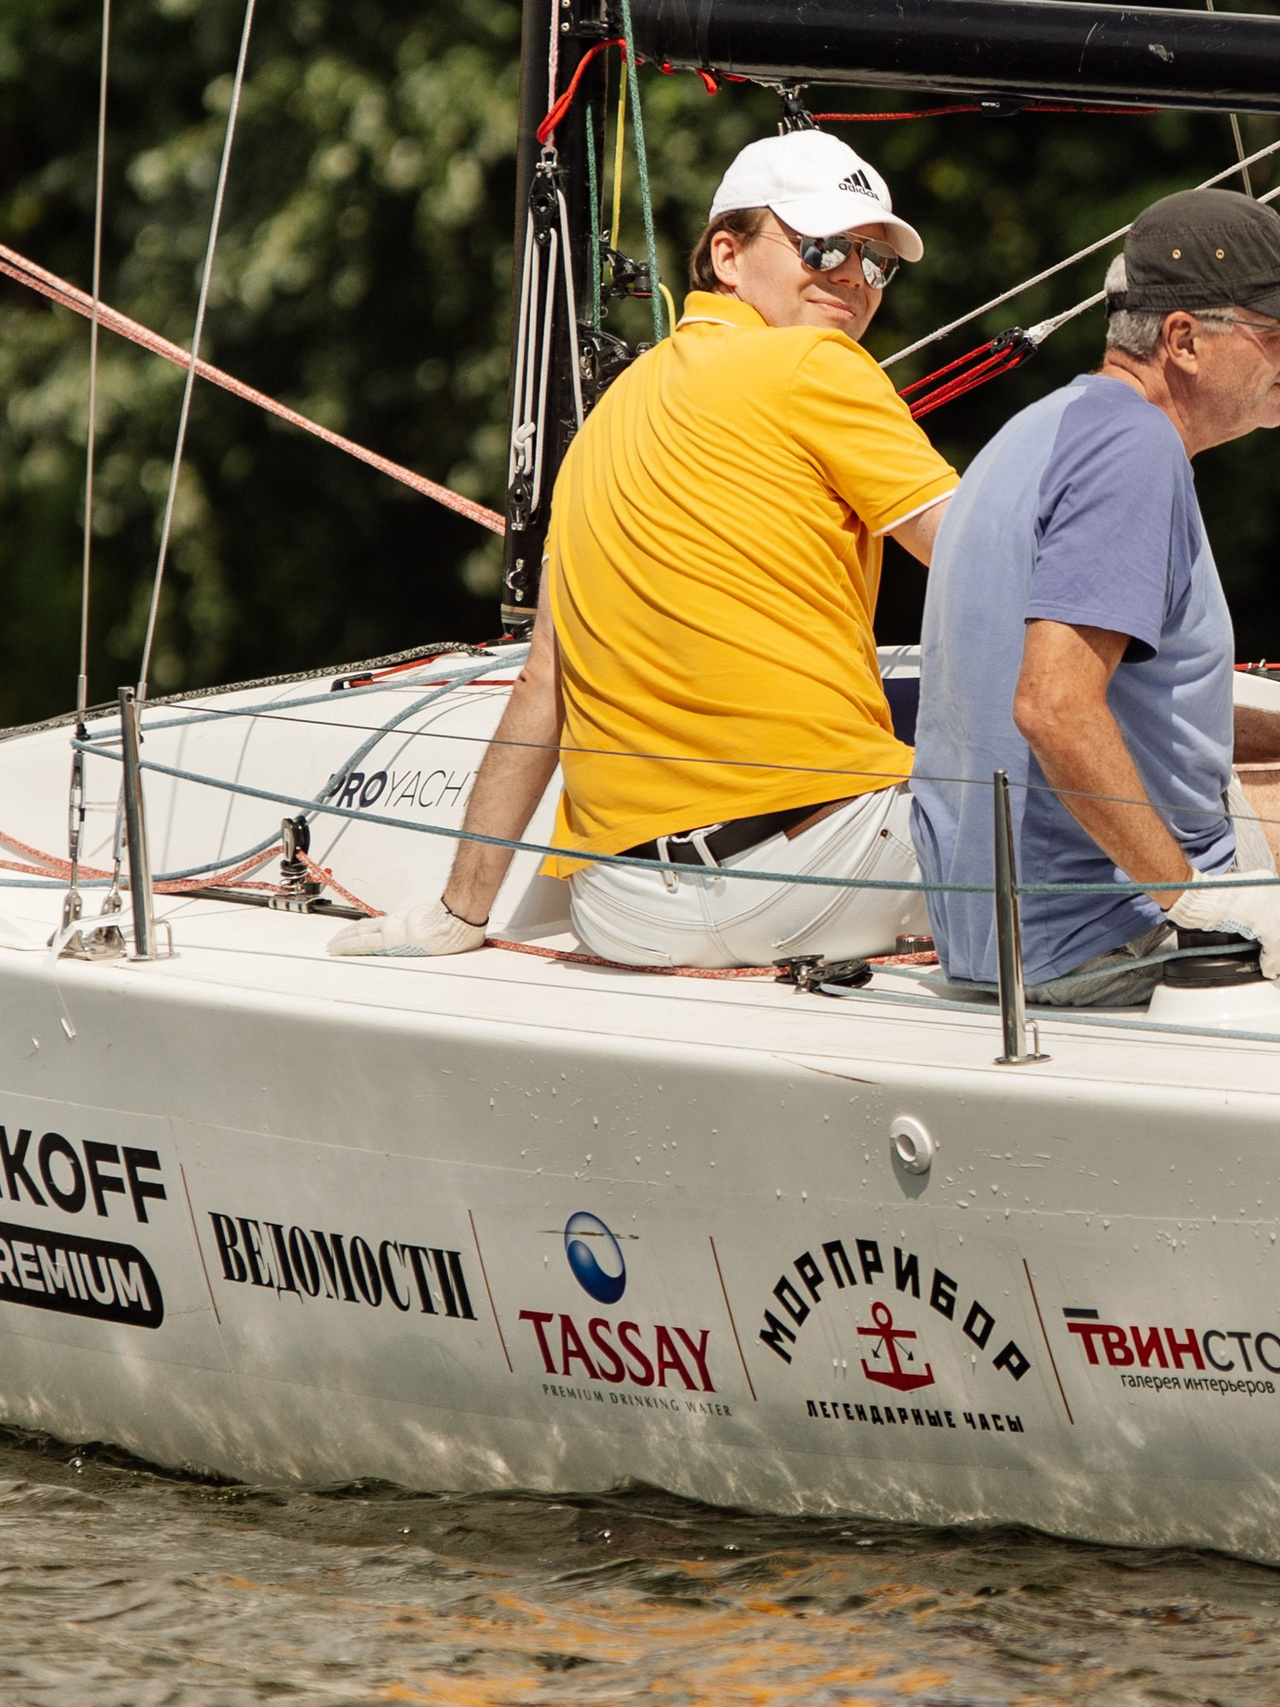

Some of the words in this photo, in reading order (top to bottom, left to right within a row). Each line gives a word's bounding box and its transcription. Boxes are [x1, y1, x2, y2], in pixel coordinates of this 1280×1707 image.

[325, 770, 479, 808] ROYACH
[0, 1125, 167, 1224] KOFF
[208, 1211, 478, 1321] ВЕДОМОСТИ
[758, 1238, 1032, 1382] МОРПРИБОР
[518, 1310, 717, 1393] TASSAY
[542, 1384, 604, 1403] PREMIUM
[609, 1392, 680, 1412] DRINKING
[685, 1401, 732, 1417] WATER
[1120, 1374, 1182, 1393] галерея
[1183, 1377, 1276, 1397] интерьеров
[805, 1400, 957, 1429] ЛЕГЕНДАРНЫЕ
[962, 1411, 1025, 1433] ЧАСЫ
